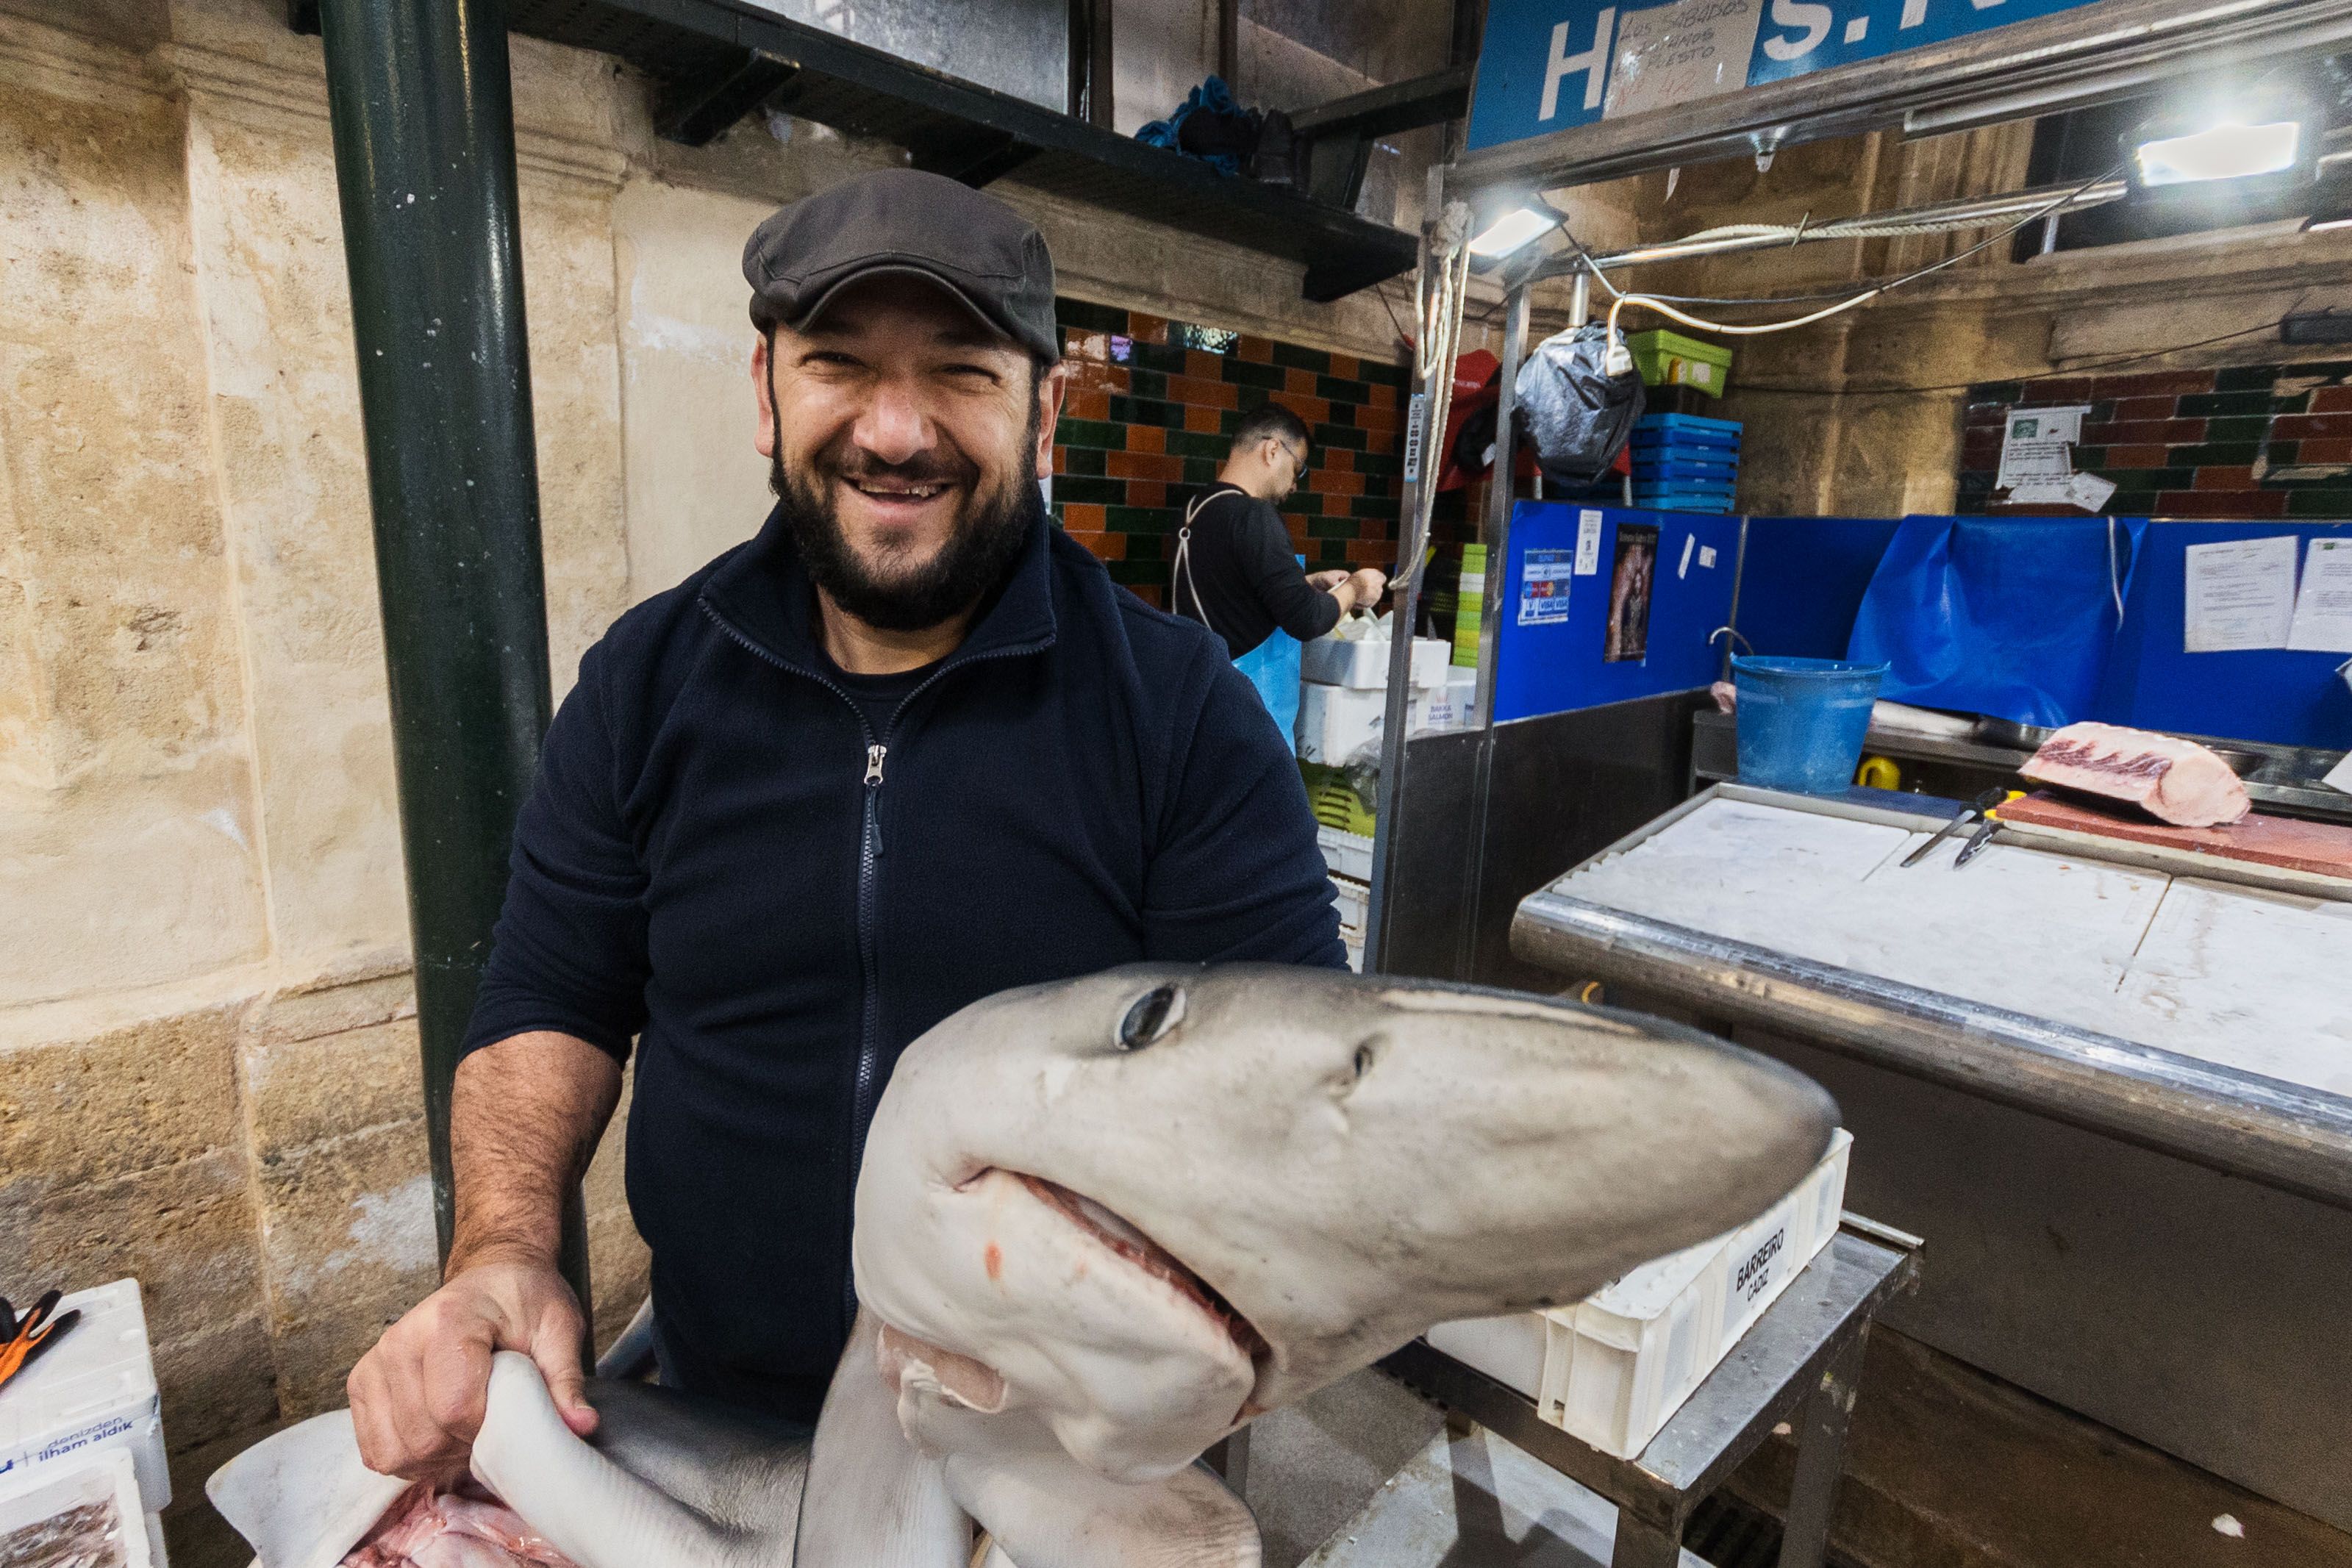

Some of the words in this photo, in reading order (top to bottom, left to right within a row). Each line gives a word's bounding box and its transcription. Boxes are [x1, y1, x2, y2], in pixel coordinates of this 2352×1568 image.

[1538, 0, 1869, 121] HS.
[1737, 1227, 1784, 1292] BARREIRO
[1748, 1267, 1769, 1302] CADIZ
[48, 1417, 123, 1448] denizden
[39, 1439, 87, 1462] ilham
